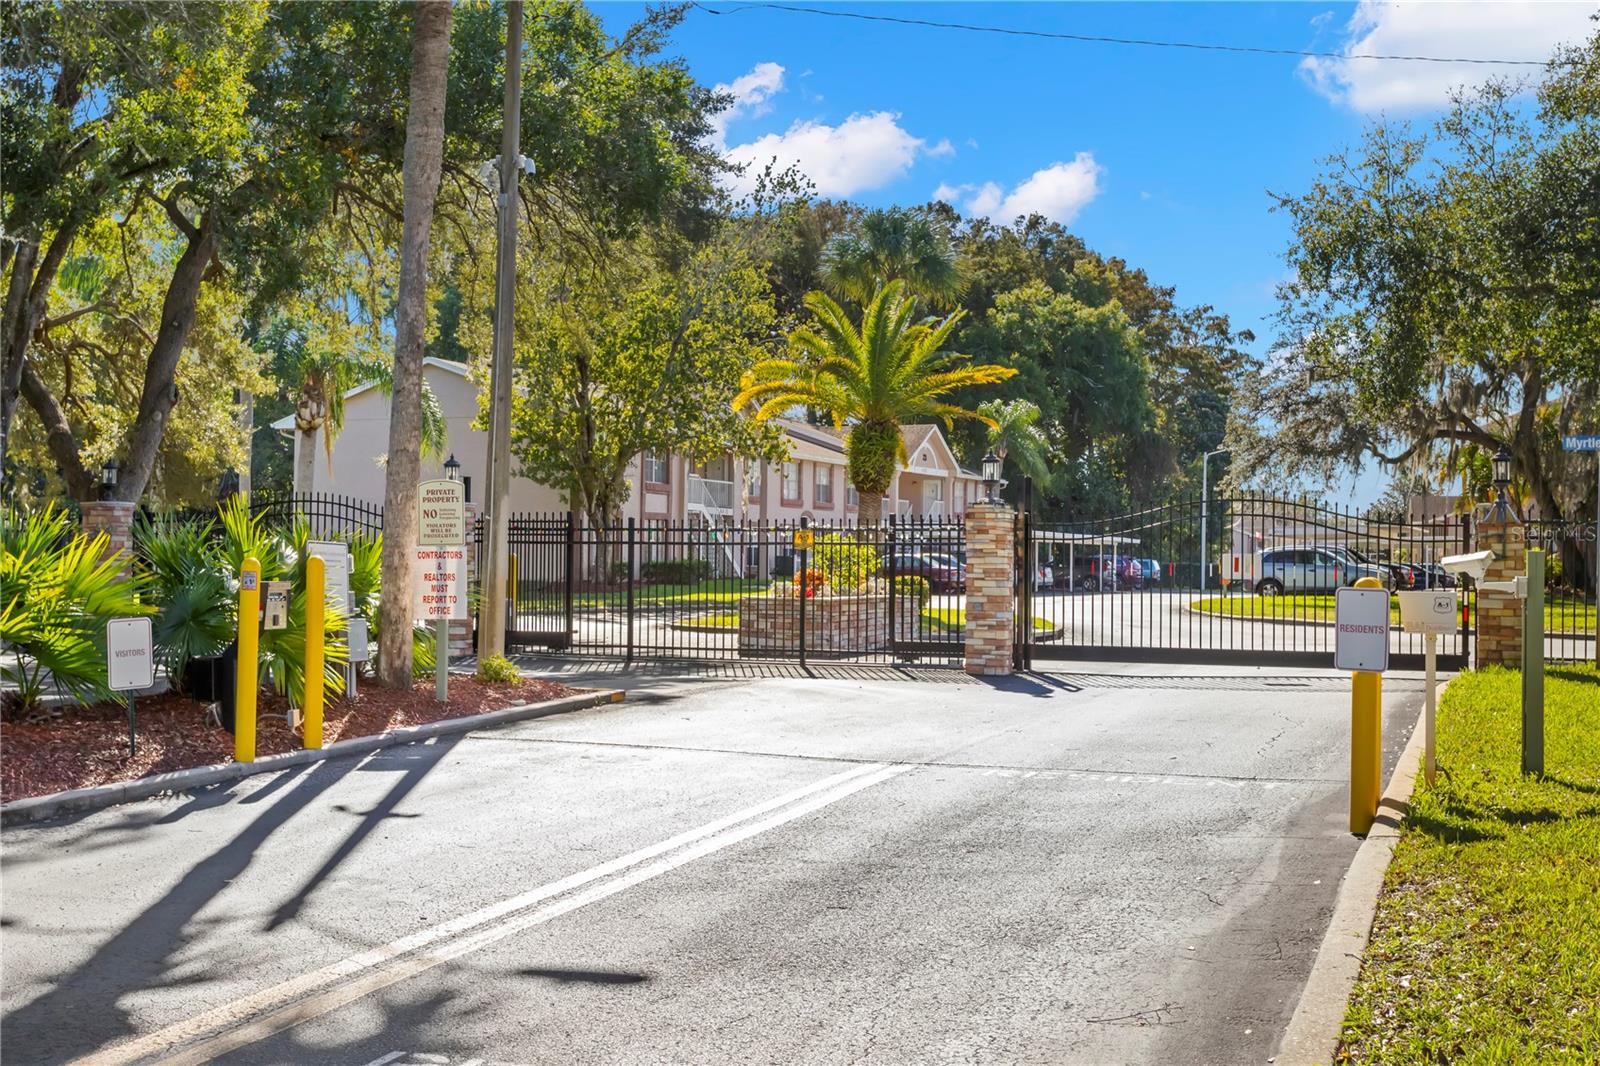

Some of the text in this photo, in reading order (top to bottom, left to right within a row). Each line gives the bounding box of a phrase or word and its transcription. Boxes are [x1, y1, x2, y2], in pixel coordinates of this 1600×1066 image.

[423, 509, 438, 519] NO
[417, 551, 463, 559] CONTRACTORS
[437, 562, 442, 570] &
[424, 573, 456, 581] REALTORS
[431, 584, 448, 592] MUST
[422, 595, 457, 603] REPORT TO
[429, 606, 451, 615] OFFICE
[1339, 624, 1385, 634] RESIDENTS
[114, 648, 146, 658] VISITORS
